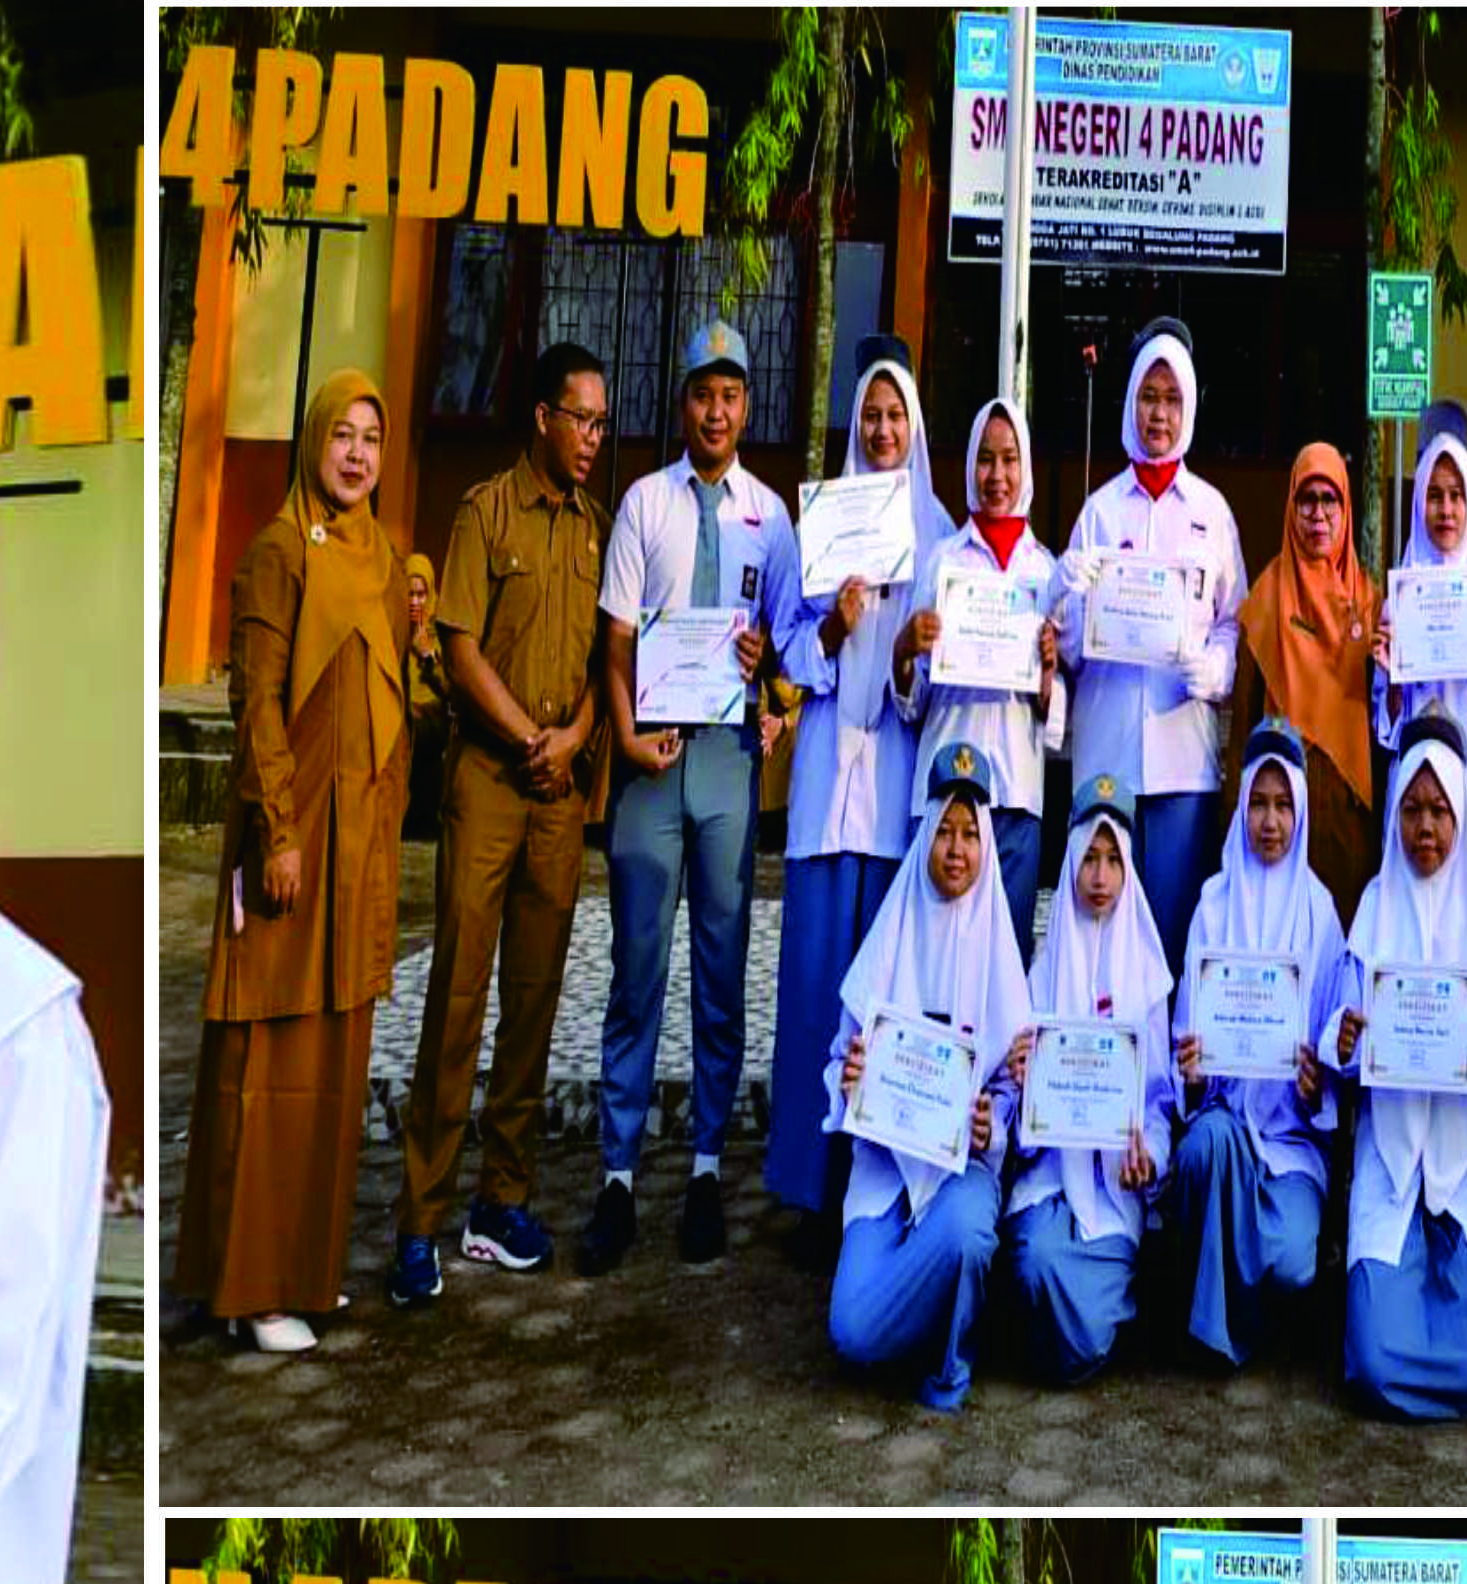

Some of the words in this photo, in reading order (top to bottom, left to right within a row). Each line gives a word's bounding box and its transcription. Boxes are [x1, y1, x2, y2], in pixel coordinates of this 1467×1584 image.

[971, 97, 1008, 151] SM
[1034, 100, 1130, 158] NEGERI
[1139, 105, 1152, 159] 4
[1162, 107, 1265, 166] PADANG
[1036, 165, 1165, 193] TERAKREDITASI
[1215, 1554, 1292, 1577] PEMERINTAH
[1353, 1559, 1417, 1583] SUMATERA
[1421, 1562, 1460, 1584] BARAT
